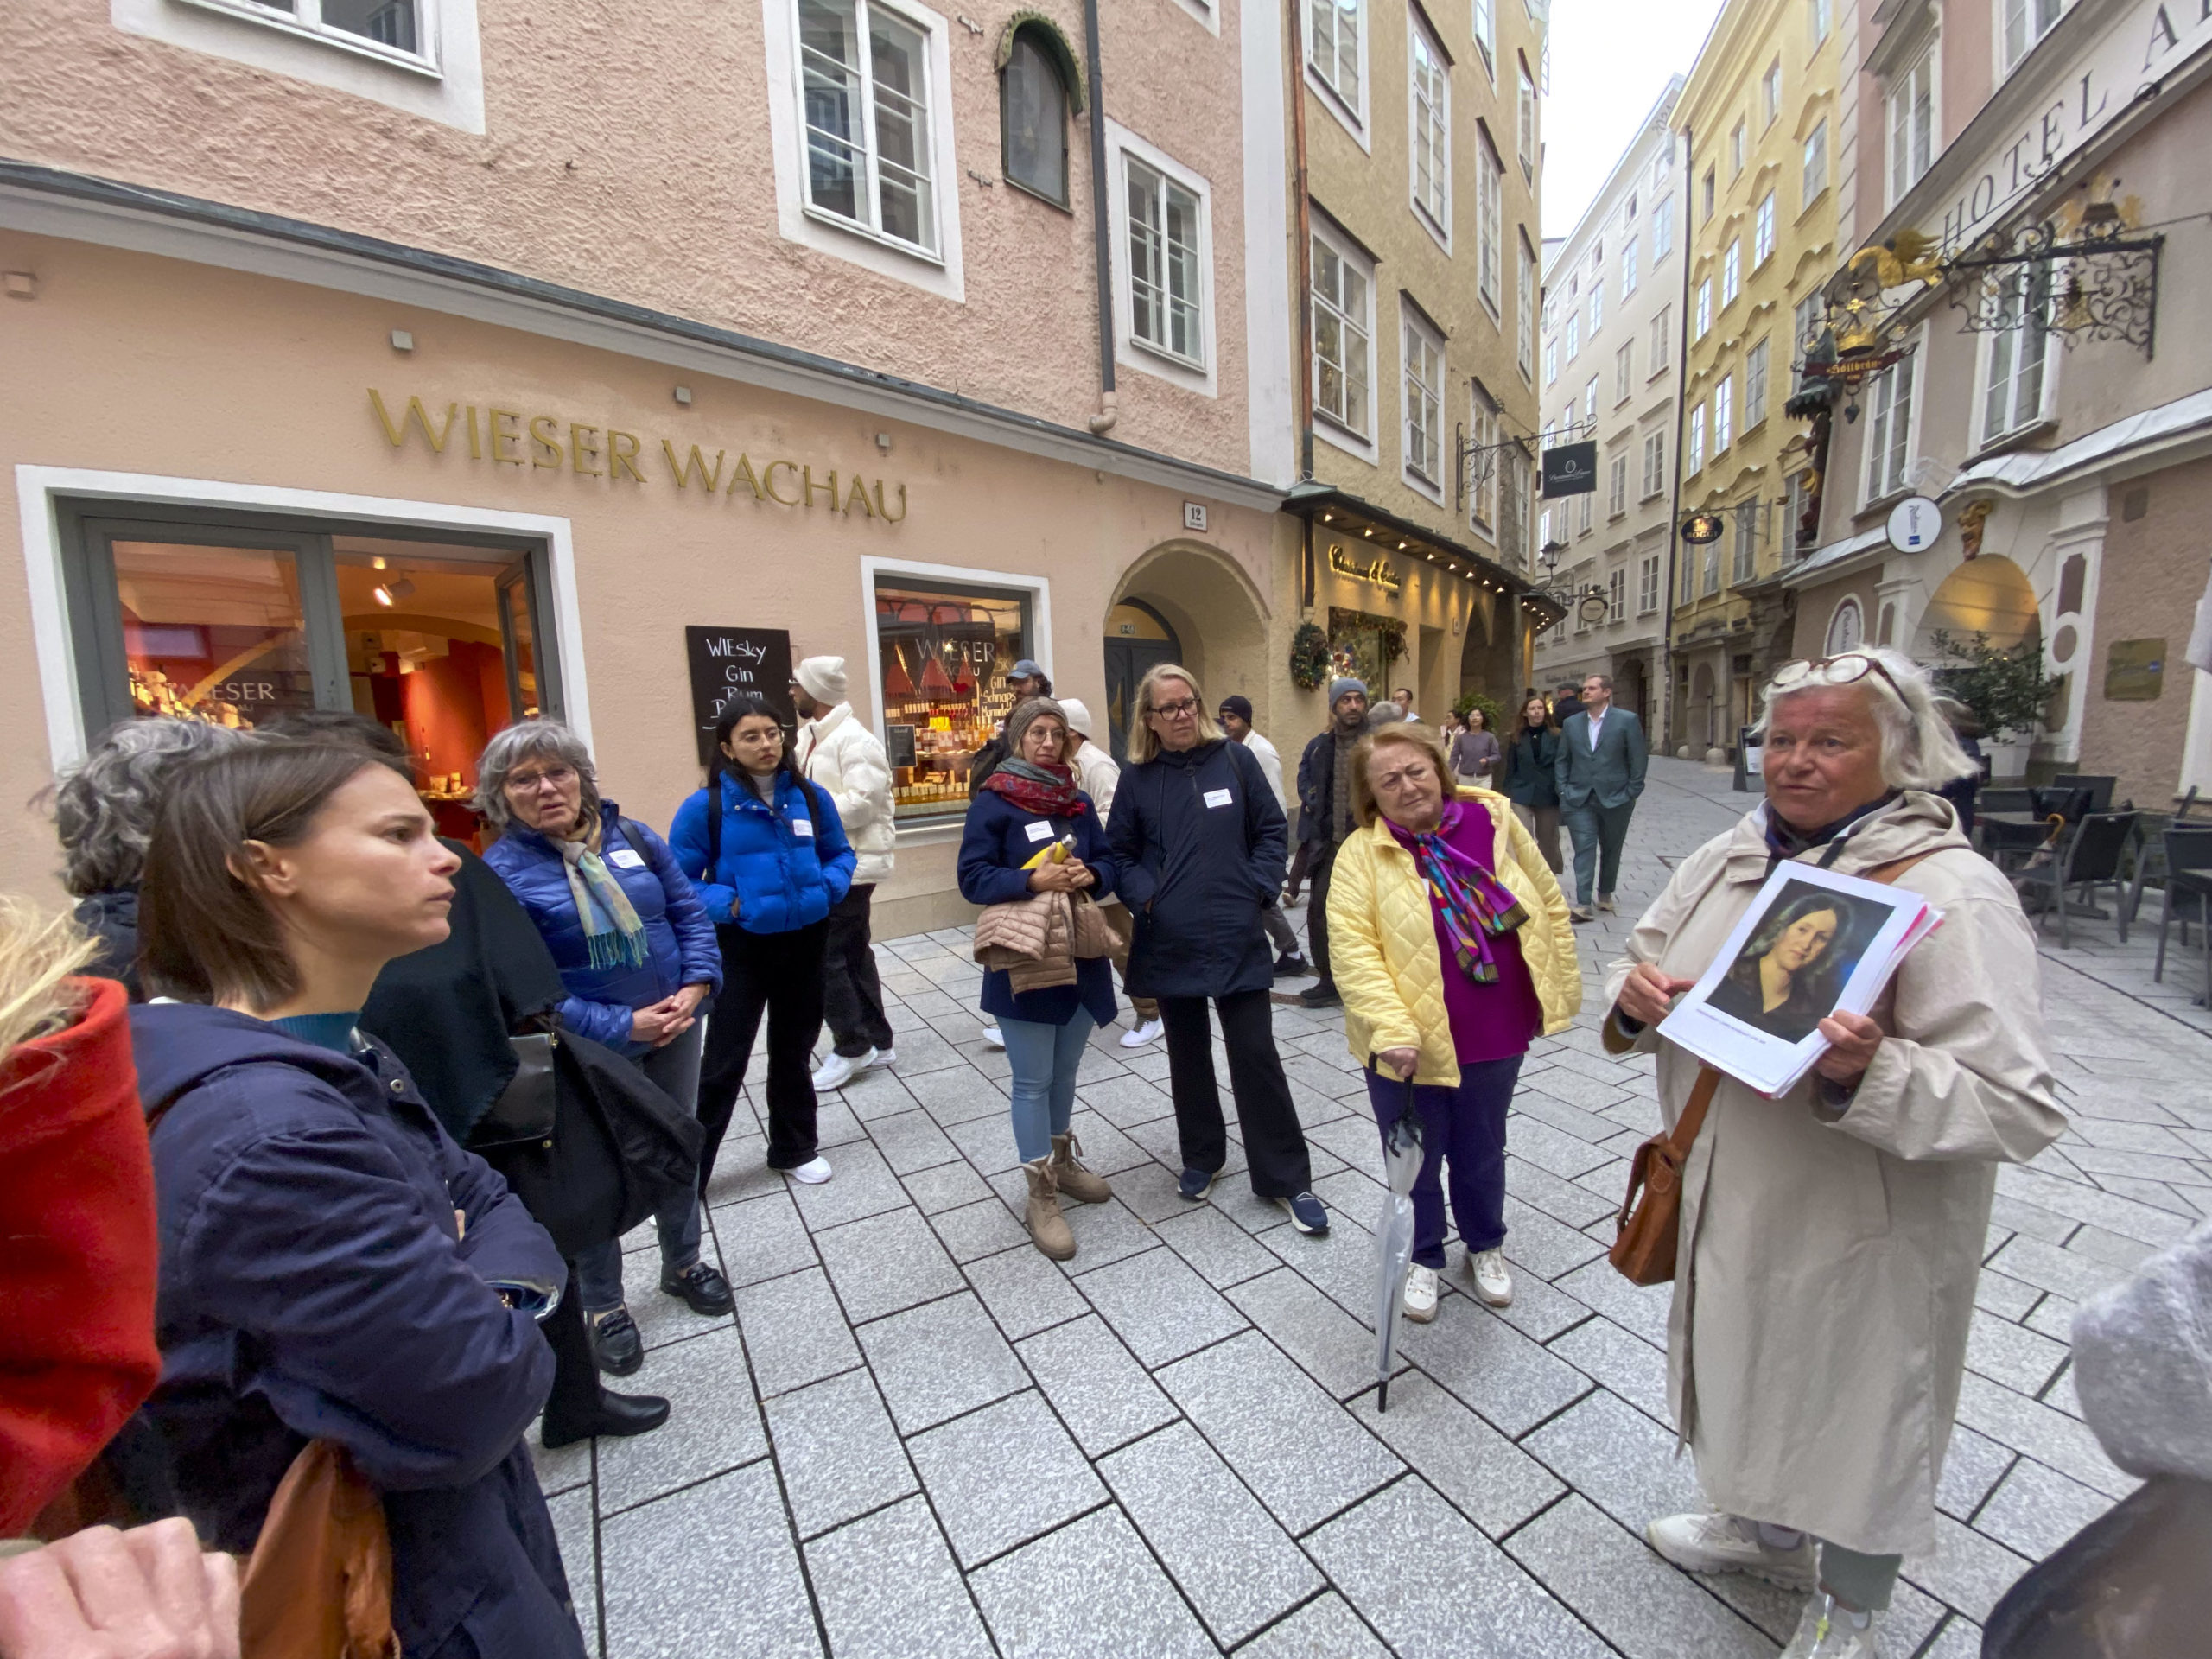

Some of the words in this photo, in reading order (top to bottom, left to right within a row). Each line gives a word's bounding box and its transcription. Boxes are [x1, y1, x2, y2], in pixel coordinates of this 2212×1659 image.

[1943, 69, 2108, 252] HOTEL
[367, 387, 647, 483] WIESER
[661, 439, 906, 522] WACHAU
[1191, 506, 1201, 521] 12
[726, 664, 753, 683] Gin
